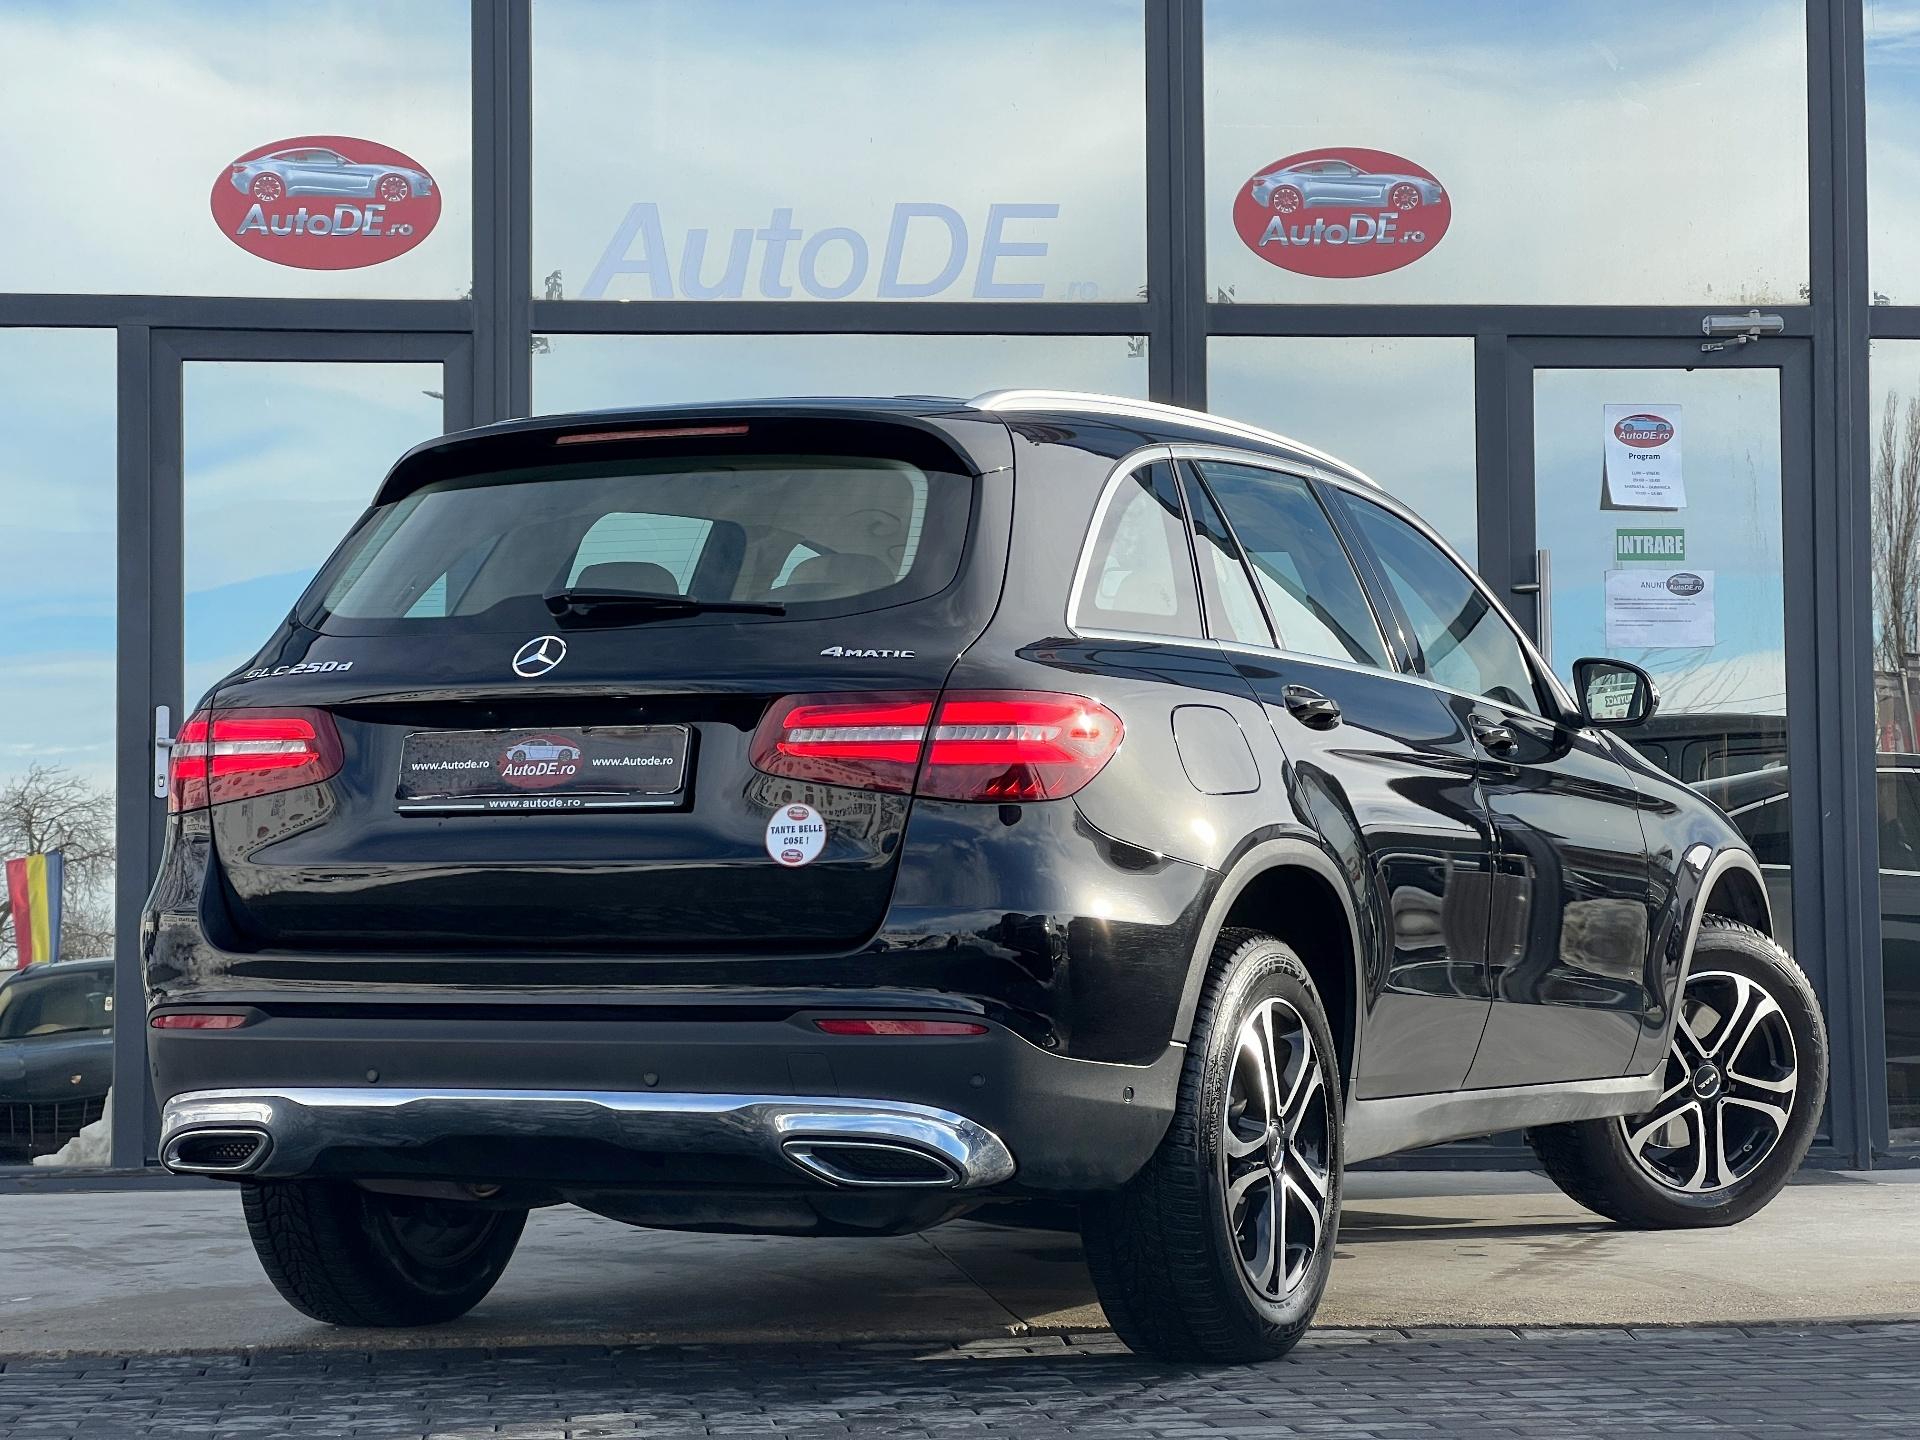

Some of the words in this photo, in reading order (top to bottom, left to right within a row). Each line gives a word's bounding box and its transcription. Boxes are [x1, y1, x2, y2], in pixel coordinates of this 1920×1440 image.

[1618, 431, 1670, 441] AutoDE.ro
[1628, 453, 1661, 461] Program
[1618, 535, 1684, 554] INTRARE
[820, 646, 916, 658] 4MATIC
[411, 760, 490, 771] www.Autode.ro
[592, 755, 674, 767] www.Autode.ro
[502, 762, 577, 777] AutoDE.ro
[489, 798, 581, 808] www.autode.ro
[771, 825, 796, 834] TANTE
[798, 825, 824, 833] BELLE
[783, 836, 804, 845] COSE
